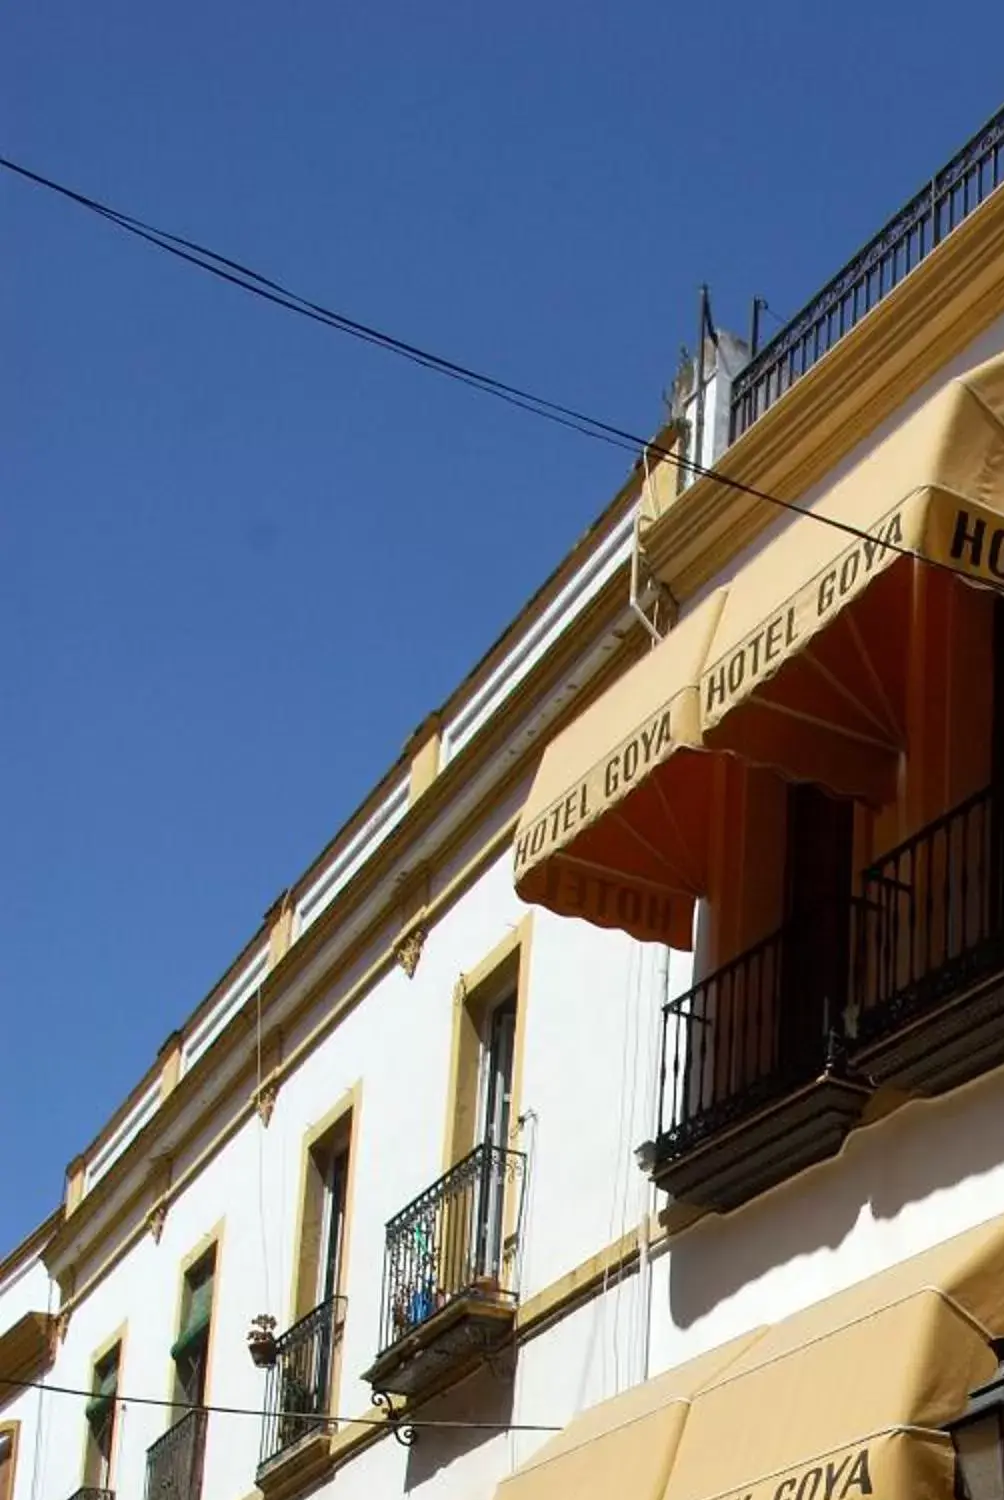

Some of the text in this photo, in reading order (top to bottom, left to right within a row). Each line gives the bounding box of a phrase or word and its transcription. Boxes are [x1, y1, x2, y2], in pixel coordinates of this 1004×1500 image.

[707, 513, 902, 712] HOTEL GOYA
[514, 711, 671, 870] HOTEL GOYA
